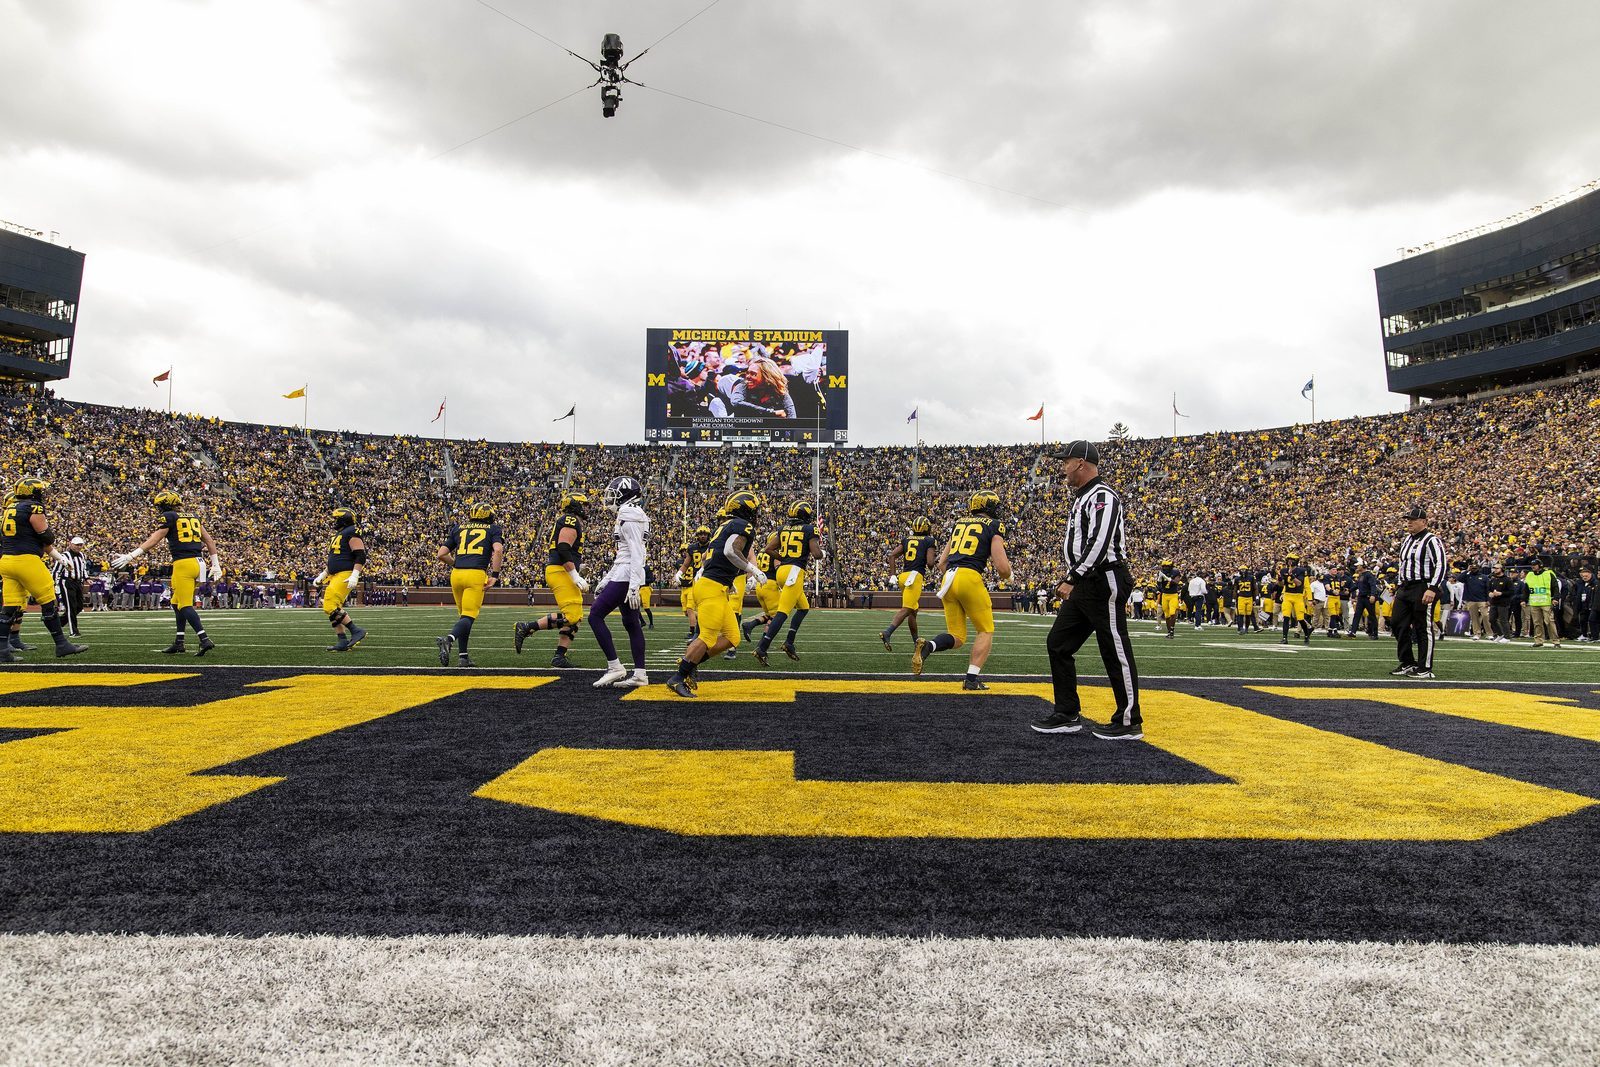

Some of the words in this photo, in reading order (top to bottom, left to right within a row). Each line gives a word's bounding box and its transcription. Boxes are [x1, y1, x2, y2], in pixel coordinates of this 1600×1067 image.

[672, 330, 750, 341] MICHIGAN
[753, 330, 823, 342] STADIUM
[647, 373, 666, 387] M
[828, 375, 847, 388] M
[803, 432, 812, 440] M
[2, 508, 17, 537] 6
[564, 516, 577, 527] 52
[176, 517, 202, 543] 89
[744, 522, 753, 535] 2
[456, 528, 487, 555] 12
[949, 523, 983, 556] 86
[905, 539, 919, 561] 6
[1238, 581, 1251, 592] 25
